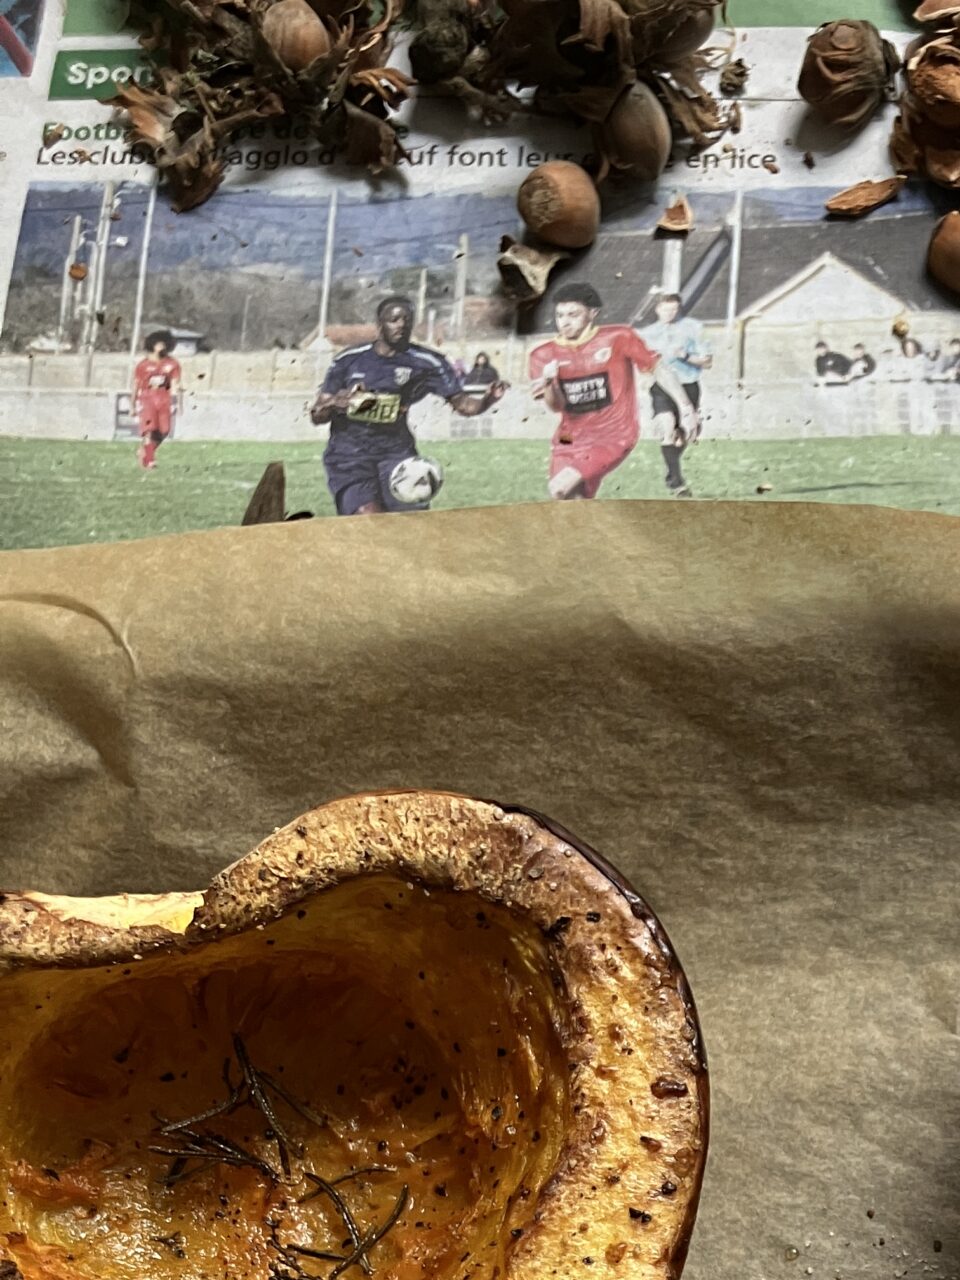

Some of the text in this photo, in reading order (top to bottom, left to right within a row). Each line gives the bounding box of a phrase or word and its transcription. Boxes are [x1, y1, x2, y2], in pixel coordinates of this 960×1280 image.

[42, 121, 126, 141] Footb
[37, 147, 80, 165] Les
[447, 145, 508, 167] font
[686, 152, 718, 169] en
[731, 148, 777, 169] lice
